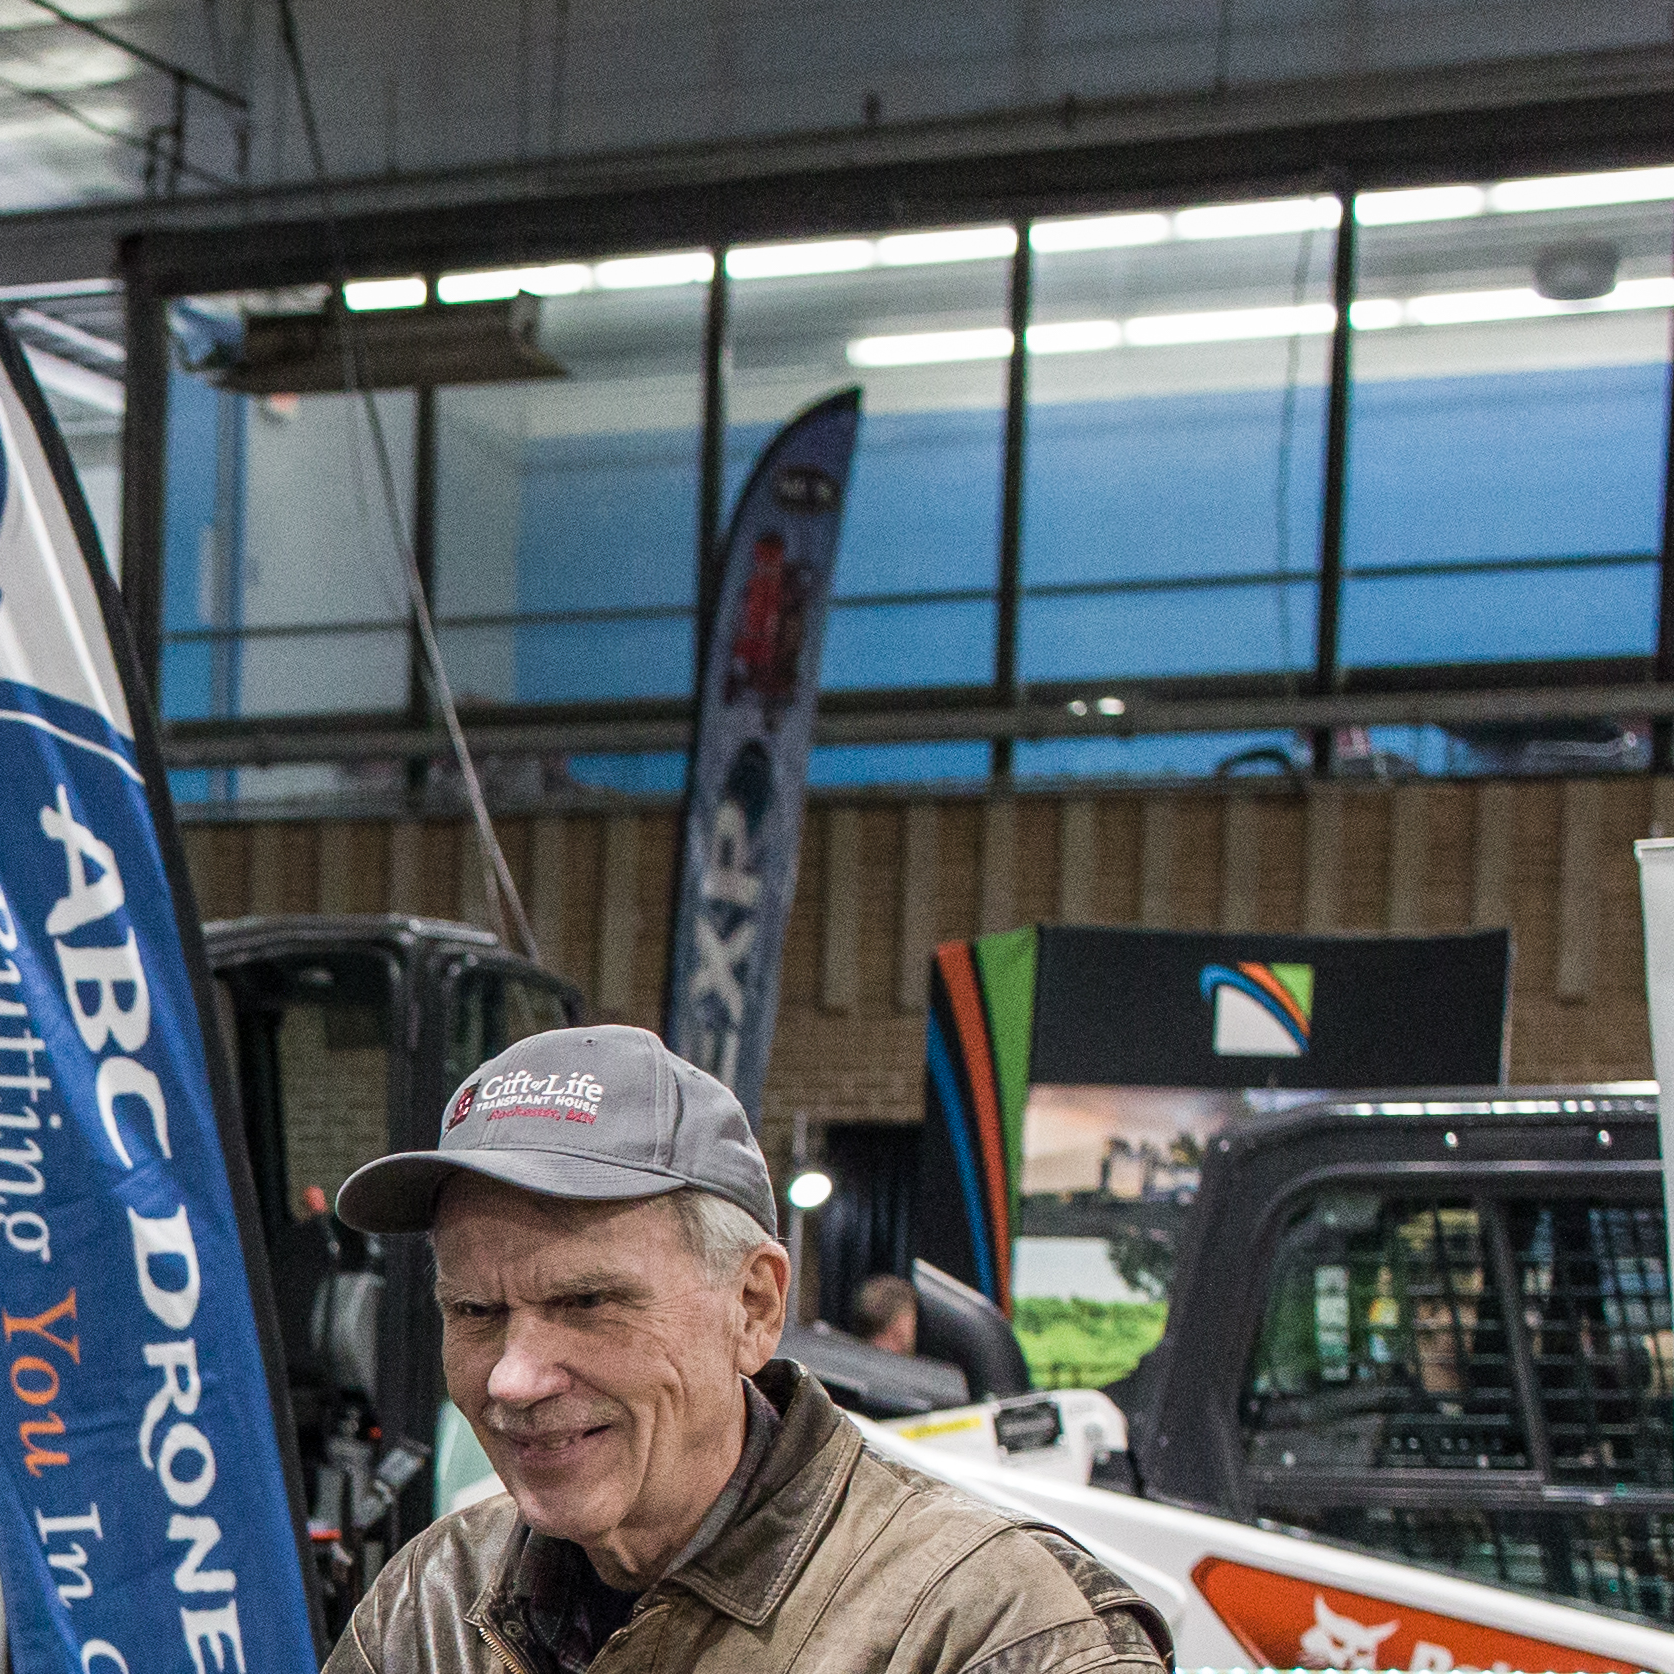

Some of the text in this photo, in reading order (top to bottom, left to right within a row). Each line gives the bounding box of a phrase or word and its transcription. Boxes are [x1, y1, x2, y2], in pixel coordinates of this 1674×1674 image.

[39, 783, 172, 1169] ABC
[476, 1094, 600, 1115] TRANSPLANT HOUSE
[482, 1070, 603, 1102] Gift of Life
[2, 1287, 81, 1478] You
[35, 1501, 104, 1608] In
